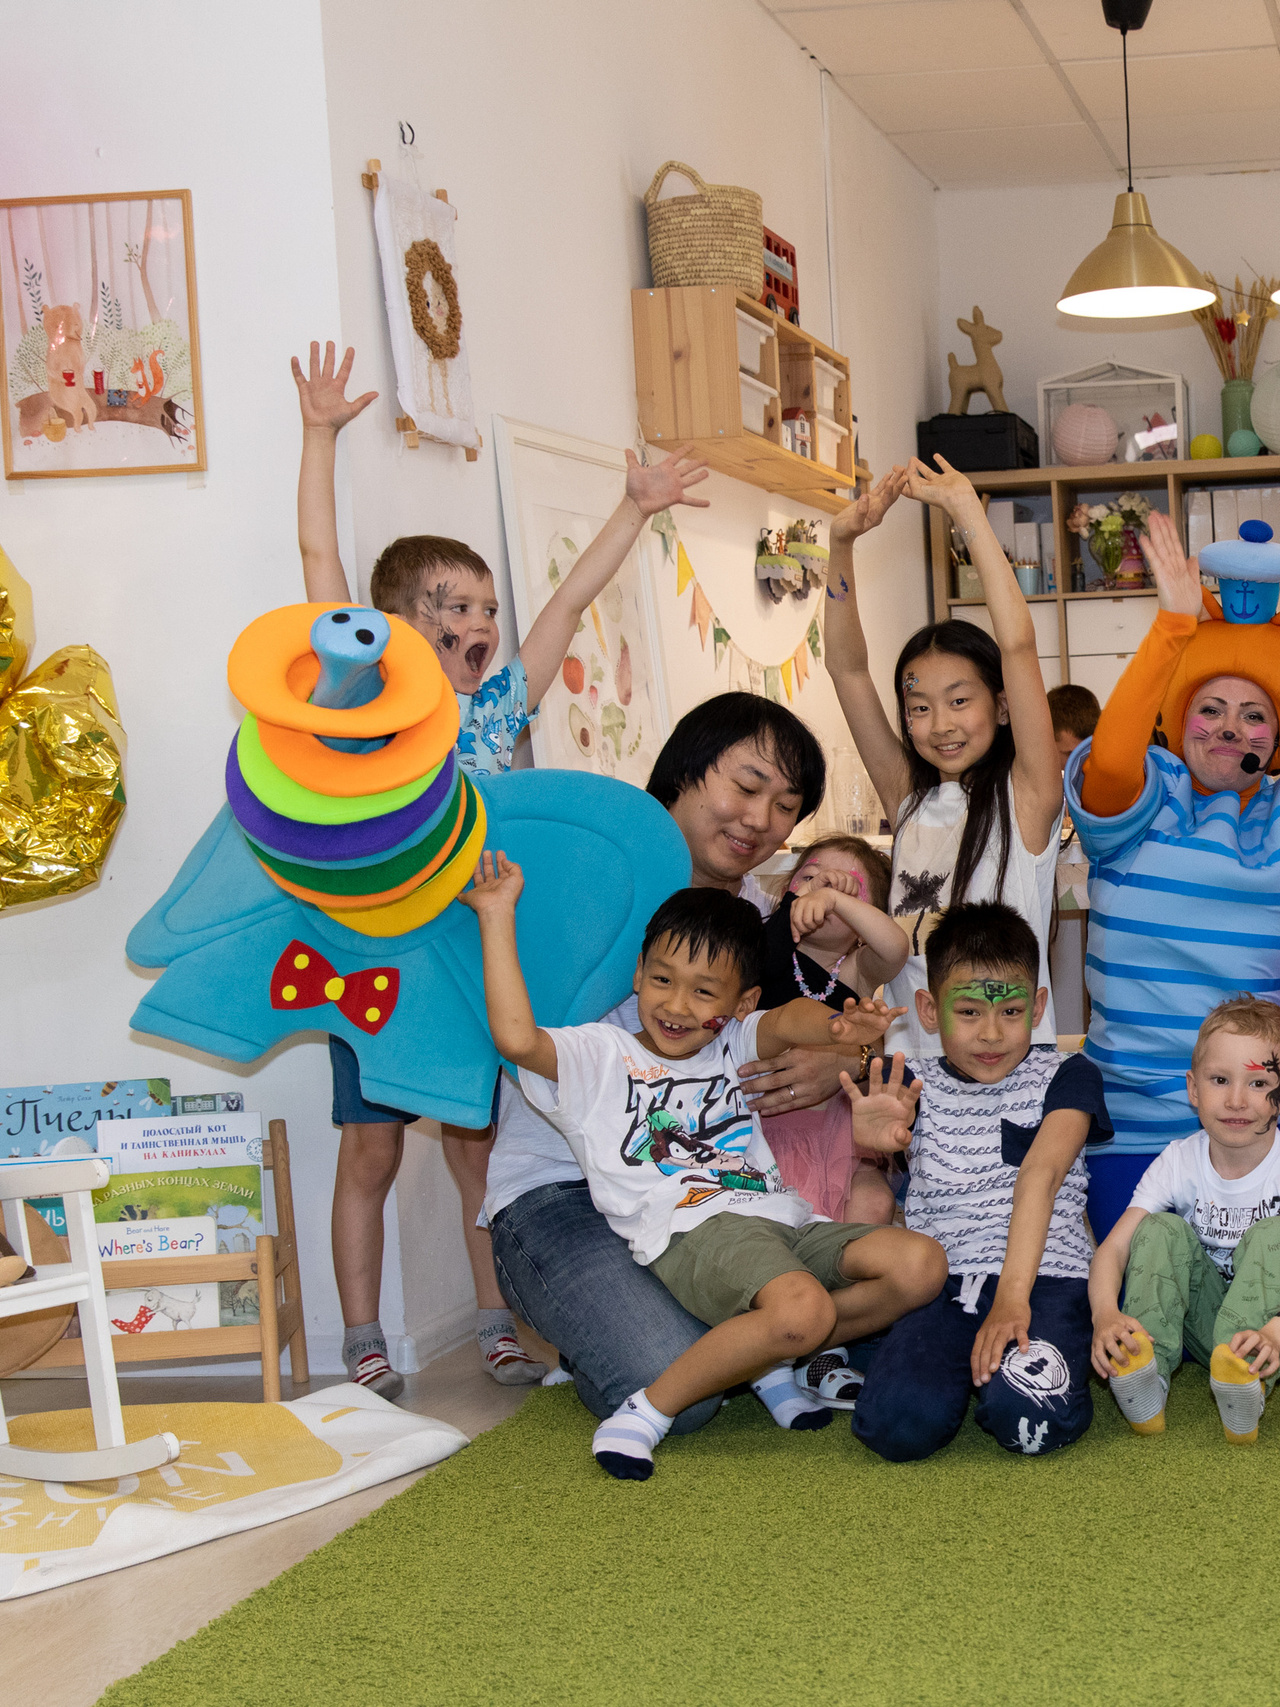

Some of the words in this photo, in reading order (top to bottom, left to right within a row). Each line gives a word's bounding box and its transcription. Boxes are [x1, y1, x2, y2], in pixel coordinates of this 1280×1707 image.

[142, 1124, 202, 1138] ПОЛОСАТЫЙ
[207, 1124, 228, 1134] КОТ
[120, 1142, 128, 1150] И
[130, 1137, 209, 1150] ТАИНСТВЕННАЯ
[211, 1135, 247, 1145] МЫШЬ
[143, 1151, 157, 1161] НА
[162, 1147, 227, 1159] КАНИКУЛАХ
[104, 1177, 156, 1201] РАЗНЫХ
[157, 1175, 211, 1188] КОНЦАХ
[212, 1178, 255, 1200] ЗЕМЛИ
[126, 1227, 143, 1236] Bear
[154, 1224, 170, 1233] Hare
[1204, 1227, 1242, 1240] JUMPING
[99, 1238, 153, 1258] Where's
[158, 1232, 204, 1252] Bear?
